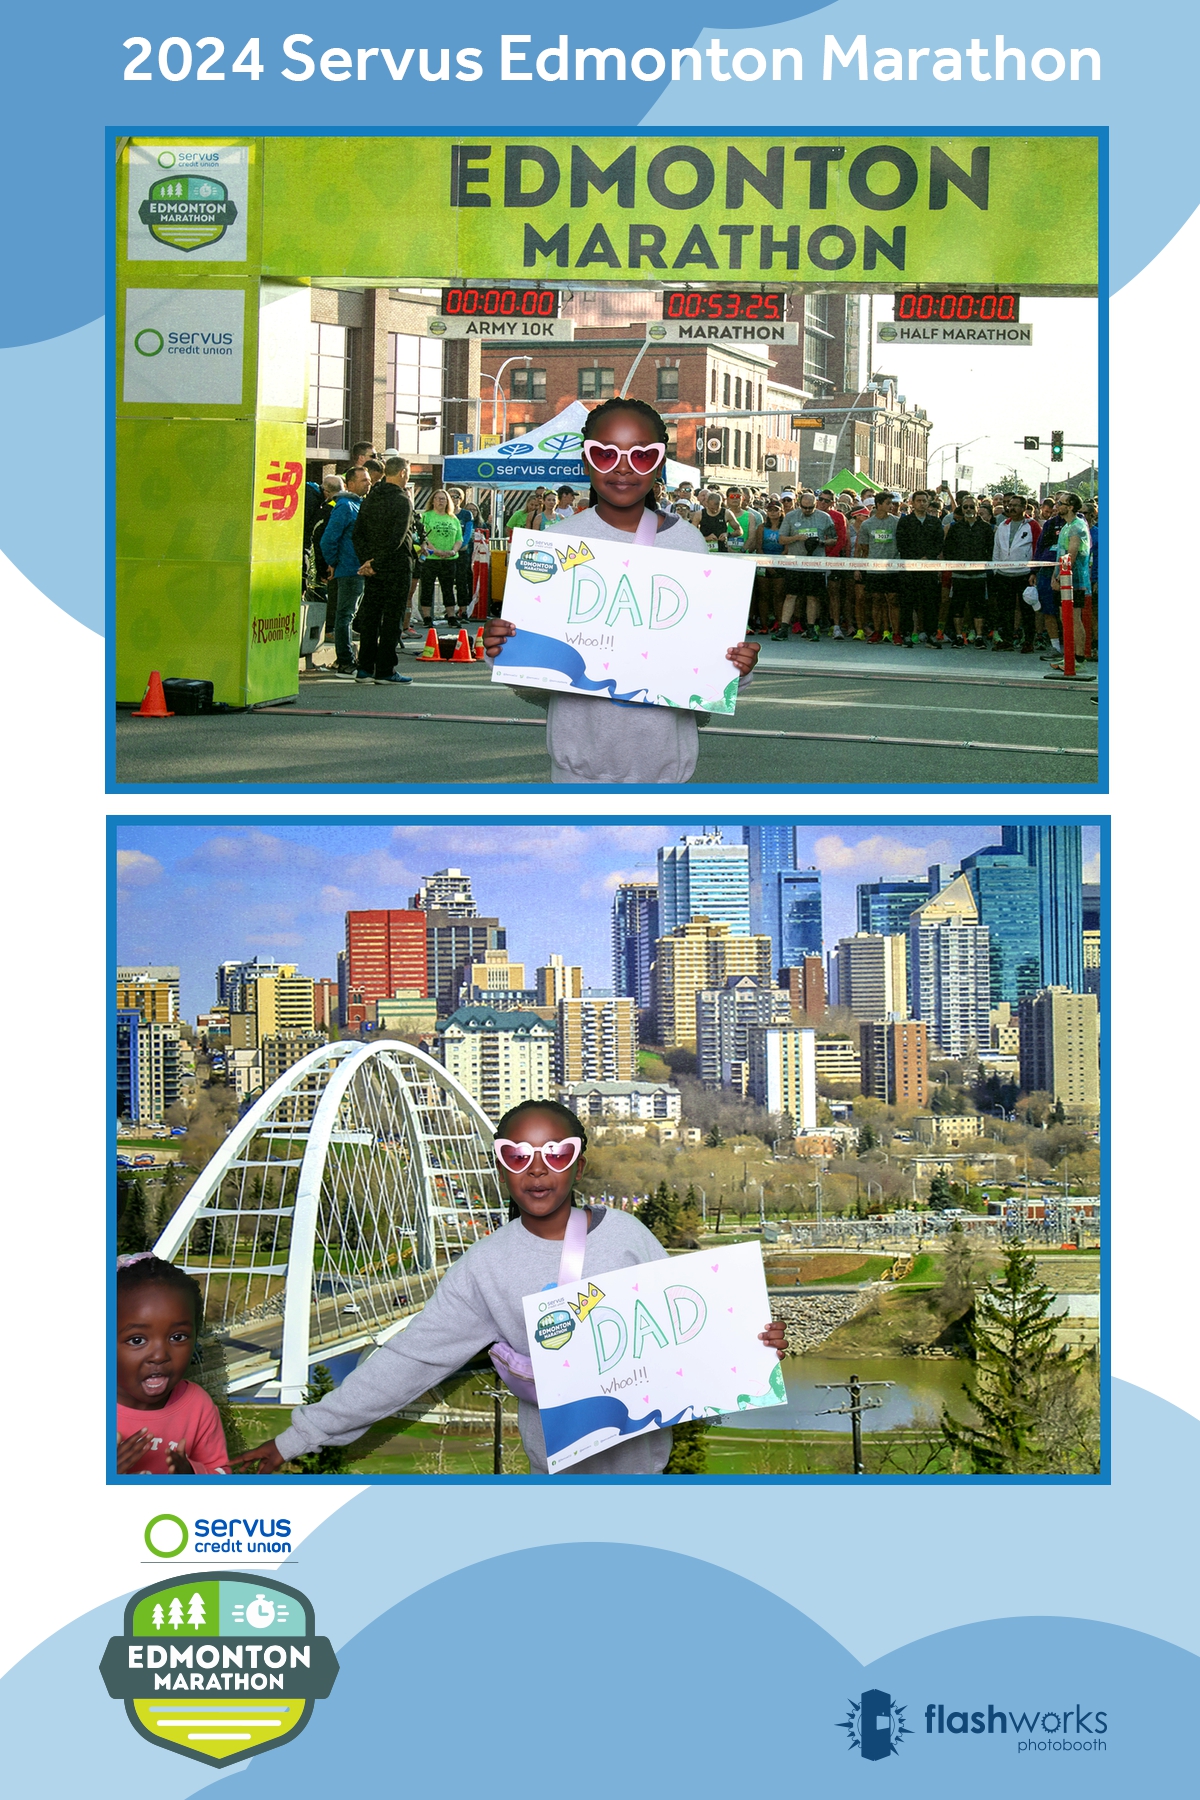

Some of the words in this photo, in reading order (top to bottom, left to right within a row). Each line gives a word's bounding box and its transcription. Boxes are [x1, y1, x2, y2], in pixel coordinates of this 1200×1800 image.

[178, 152, 219, 161] servus
[450, 144, 990, 211] EDMONTON
[149, 202, 227, 214] EDMONTON
[160, 214, 215, 222] MARATHON
[523, 223, 906, 271] MARATHON
[465, 321, 519, 336] ARMY
[521, 322, 555, 337] 10K
[678, 325, 785, 340] MARATHON
[900, 328, 939, 340] HALF
[942, 329, 1031, 341] MARATHON
[167, 331, 233, 345] servus
[167, 345, 200, 355] credit
[202, 347, 233, 356] union
[496, 464, 546, 476] servus
[520, 560, 554, 570] EDMONTON
[567, 563, 689, 631] DAD
[257, 612, 291, 644] Running
[538, 1321, 572, 1337] EDMONTON
[588, 1284, 708, 1375] DAD
